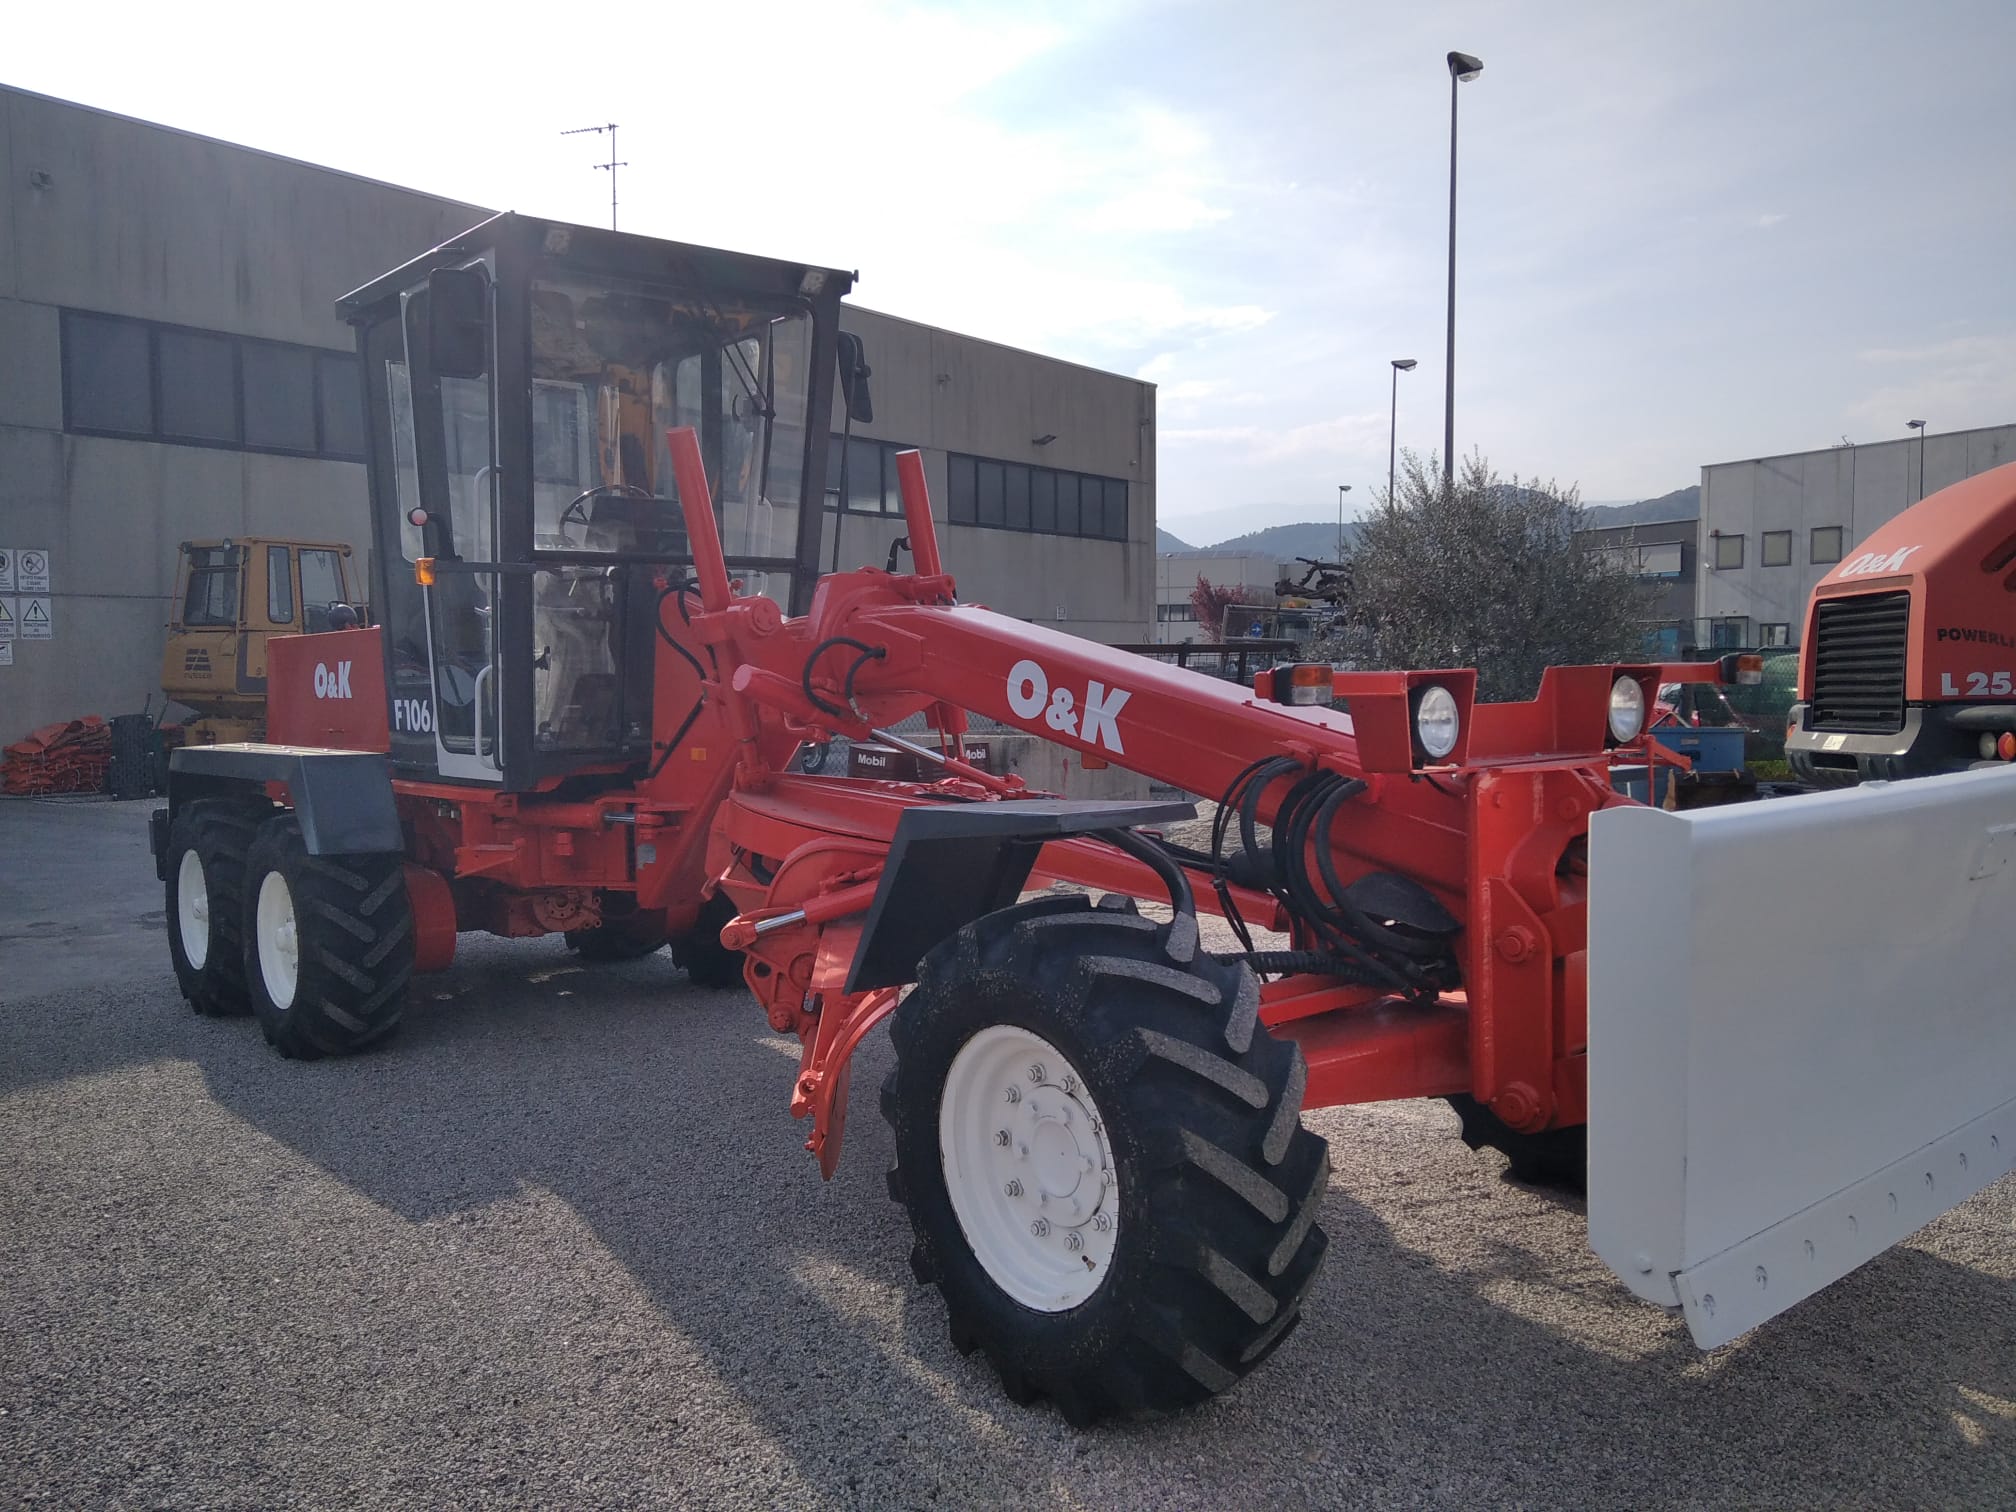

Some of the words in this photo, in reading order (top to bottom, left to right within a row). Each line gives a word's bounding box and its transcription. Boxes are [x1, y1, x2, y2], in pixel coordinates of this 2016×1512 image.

[1839, 545, 1922, 578] O&K
[315, 661, 352, 699] O&K
[1941, 672, 1959, 696] L
[1006, 659, 1132, 755] O&K
[857, 753, 886, 767] Mobil
